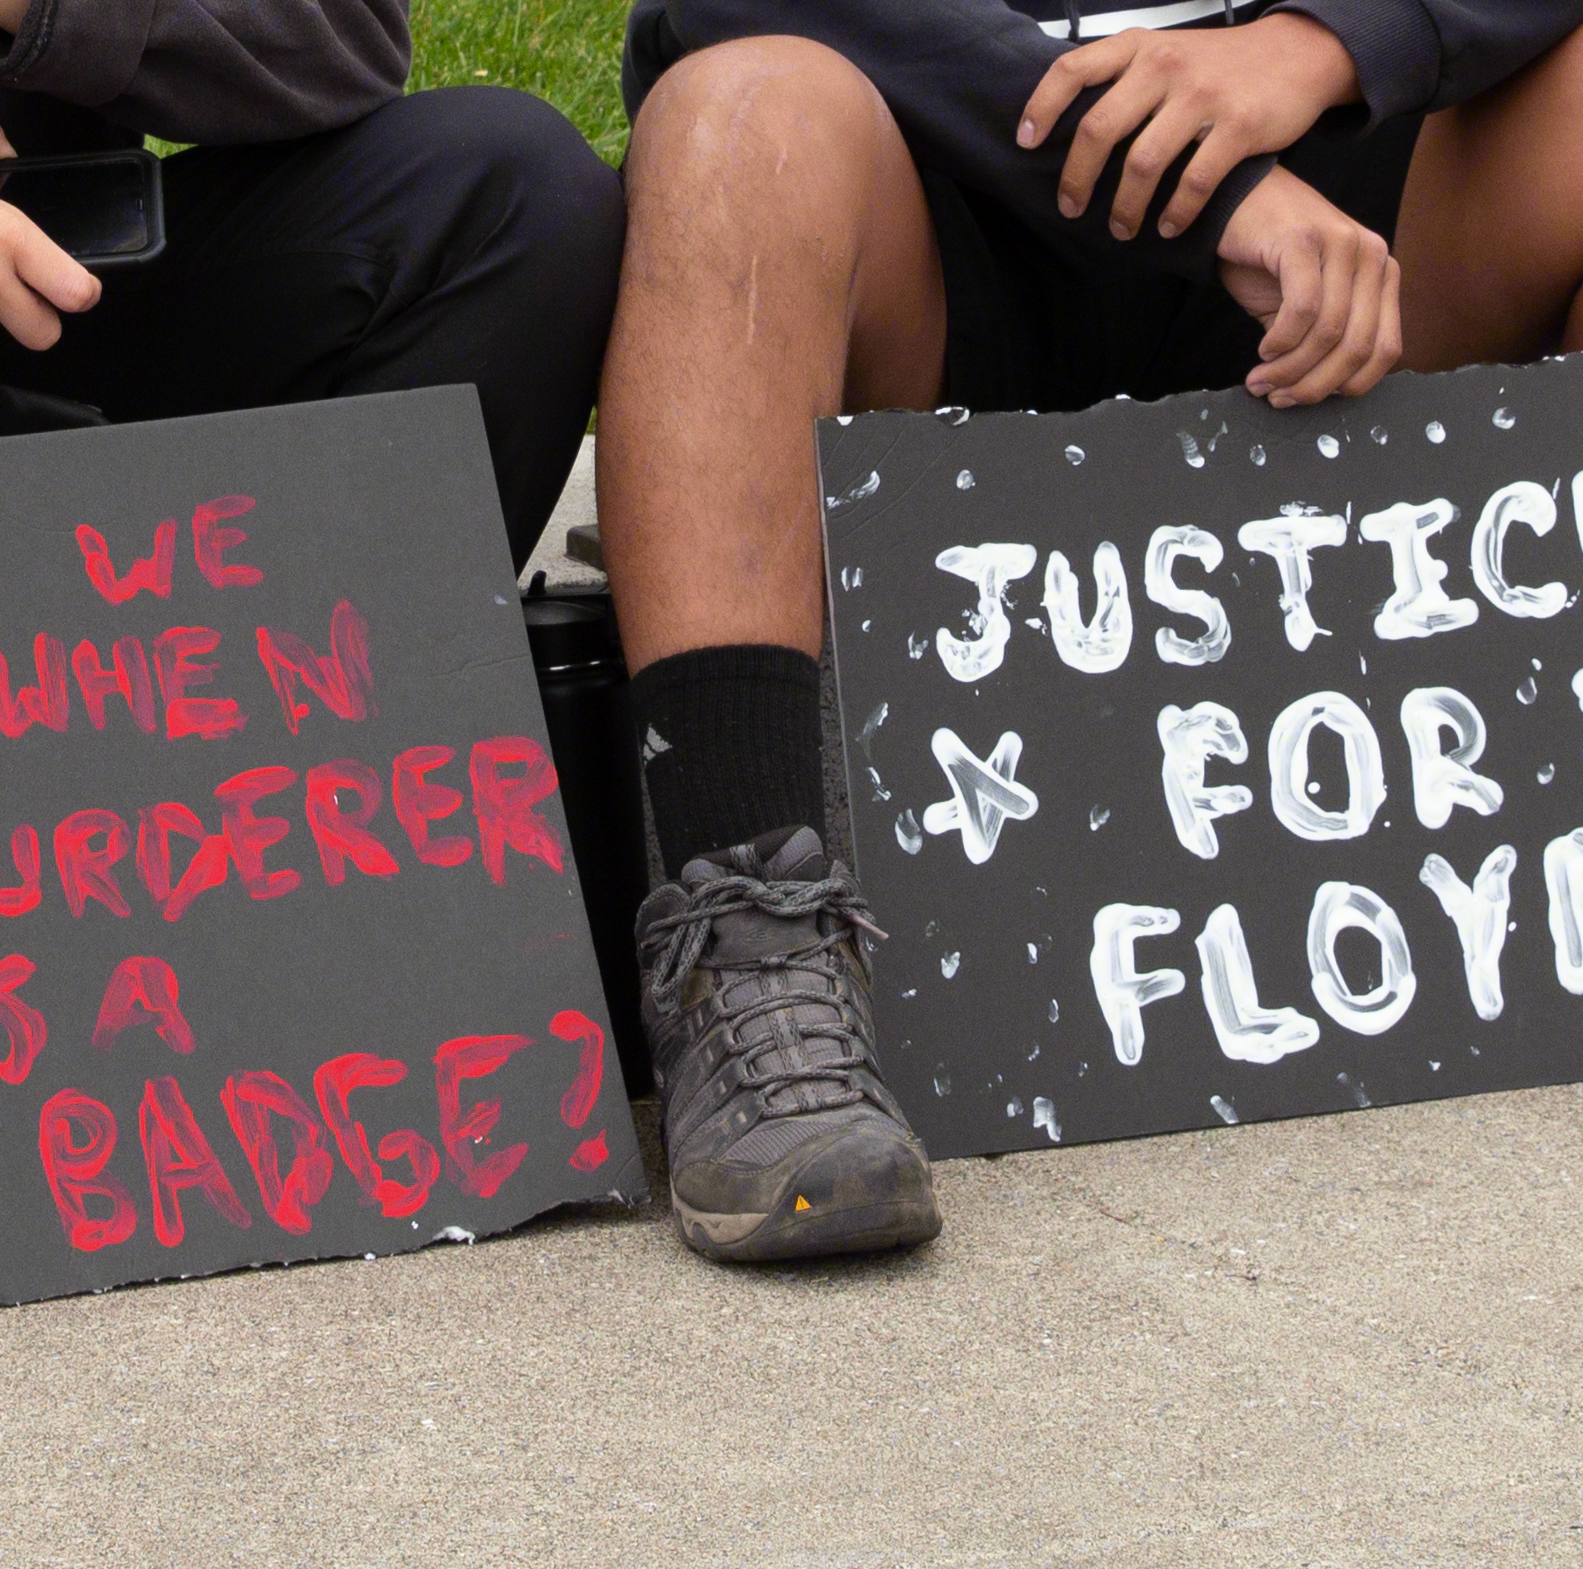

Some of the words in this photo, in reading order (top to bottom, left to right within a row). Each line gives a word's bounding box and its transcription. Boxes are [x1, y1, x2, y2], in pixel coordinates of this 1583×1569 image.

[74, 494, 265, 605] WE
[1156, 685, 1504, 859] FOR
[92, 955, 196, 1054] A
[37, 1008, 610, 1252] BADGE?
